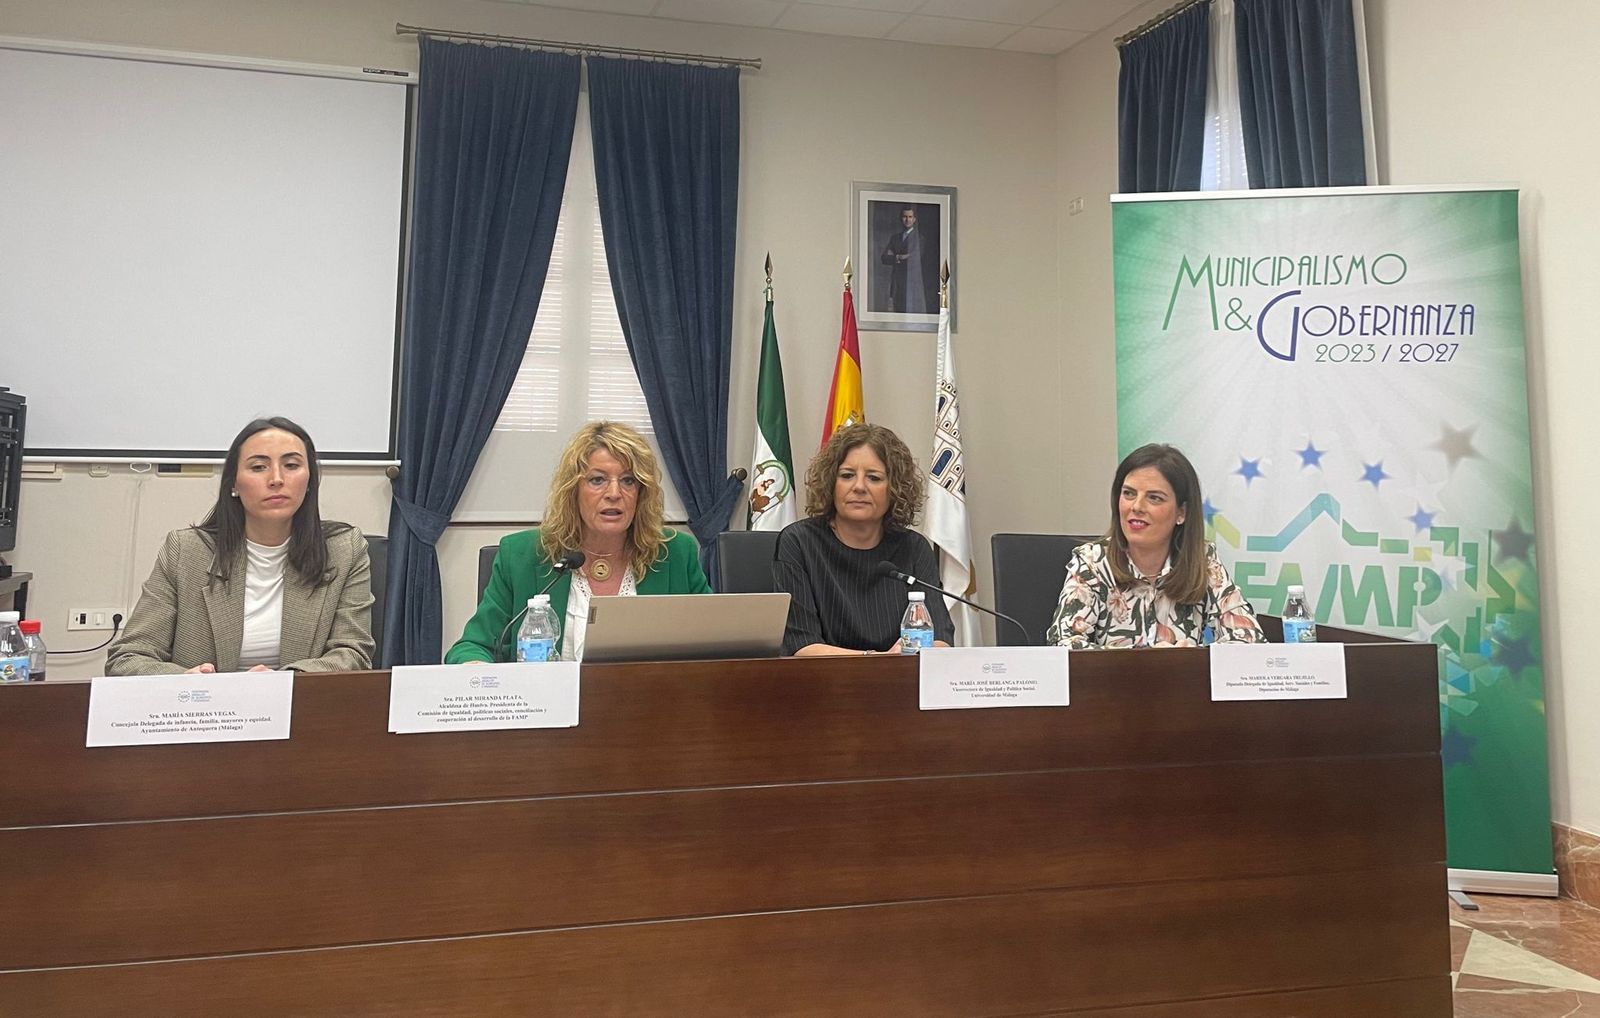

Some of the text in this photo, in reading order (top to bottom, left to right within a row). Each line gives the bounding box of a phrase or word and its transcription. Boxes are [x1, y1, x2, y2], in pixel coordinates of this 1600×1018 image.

[1162, 253, 1408, 331] MUNICIPALISMO
[1224, 290, 1475, 362] & GOBERNANZA
[1314, 343, 1460, 363] 2023 / 2027
